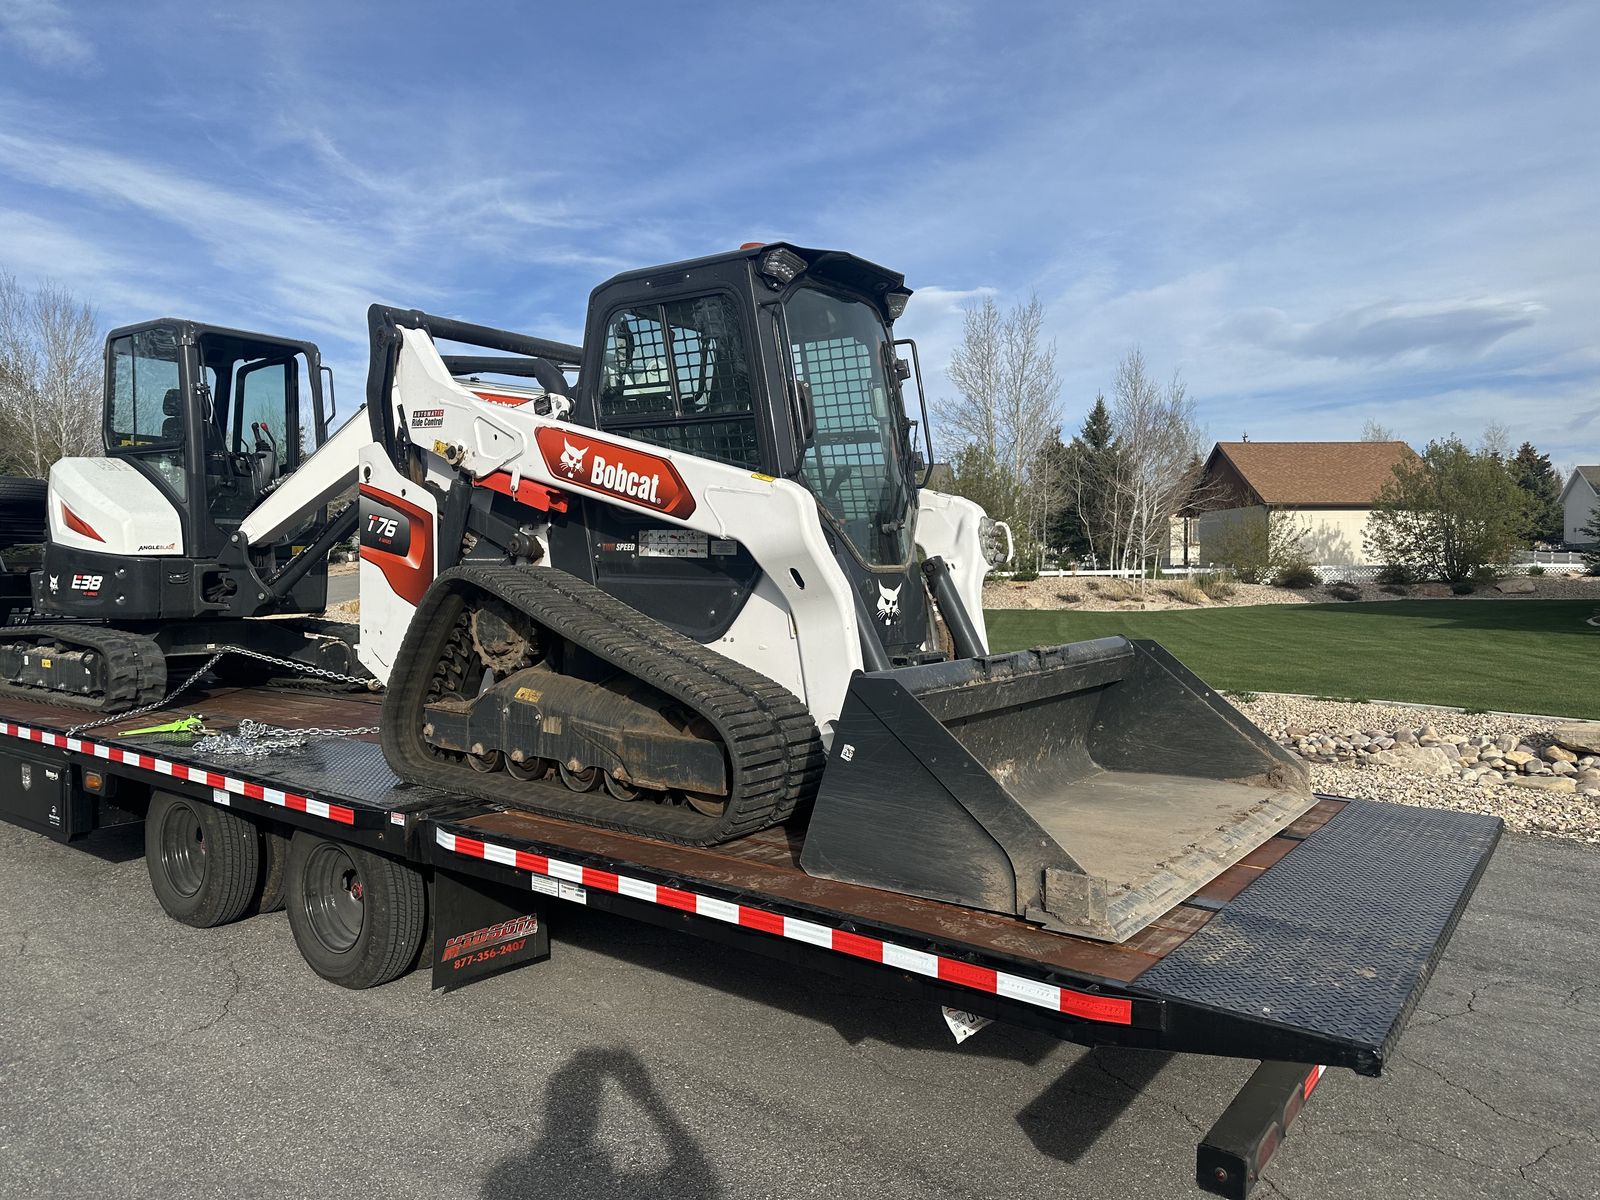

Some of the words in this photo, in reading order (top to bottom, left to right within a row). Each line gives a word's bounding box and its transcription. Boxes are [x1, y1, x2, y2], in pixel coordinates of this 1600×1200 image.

[413, 410, 444, 418] AUTOMATIC
[424, 418, 443, 426] Control
[590, 455, 659, 503] Bobcat
[367, 514, 399, 538] T76
[615, 543, 635, 551] SPEED
[71, 574, 103, 590] E38
[453, 938, 526, 970] 877-356-2407
